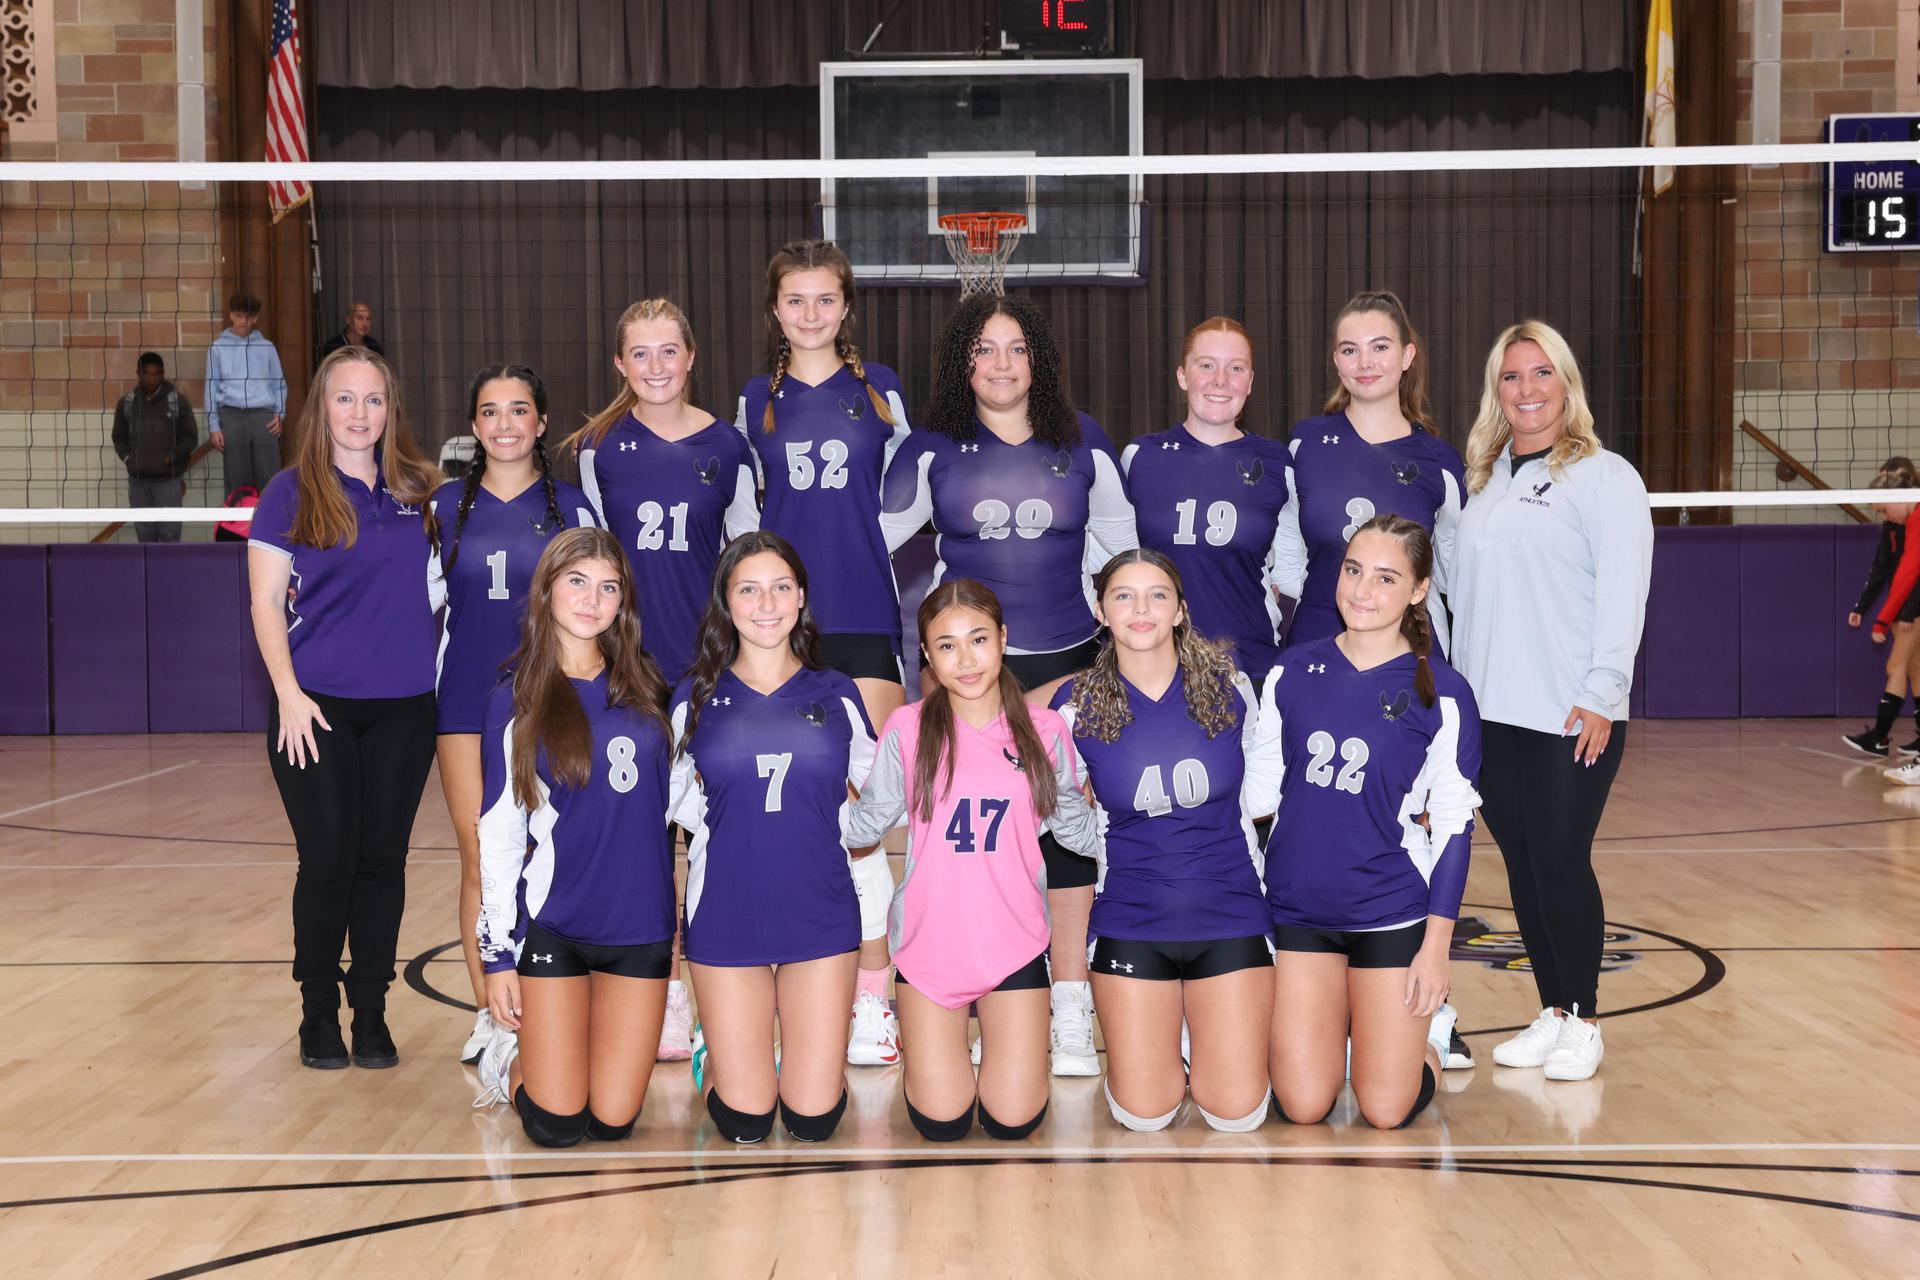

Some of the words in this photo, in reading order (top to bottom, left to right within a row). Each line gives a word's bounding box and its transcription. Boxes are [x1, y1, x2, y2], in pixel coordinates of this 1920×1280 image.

[1854, 171, 1904, 189] HOME
[1868, 196, 1906, 239] 15
[785, 438, 849, 491] 52
[637, 500, 689, 552] 21
[1173, 498, 1237, 547] 19
[486, 550, 510, 600] 1
[606, 735, 640, 793] 8
[755, 752, 793, 813] 7
[1132, 758, 1210, 819] 40
[1305, 730, 1370, 795] 22
[944, 796, 1012, 855] 47
